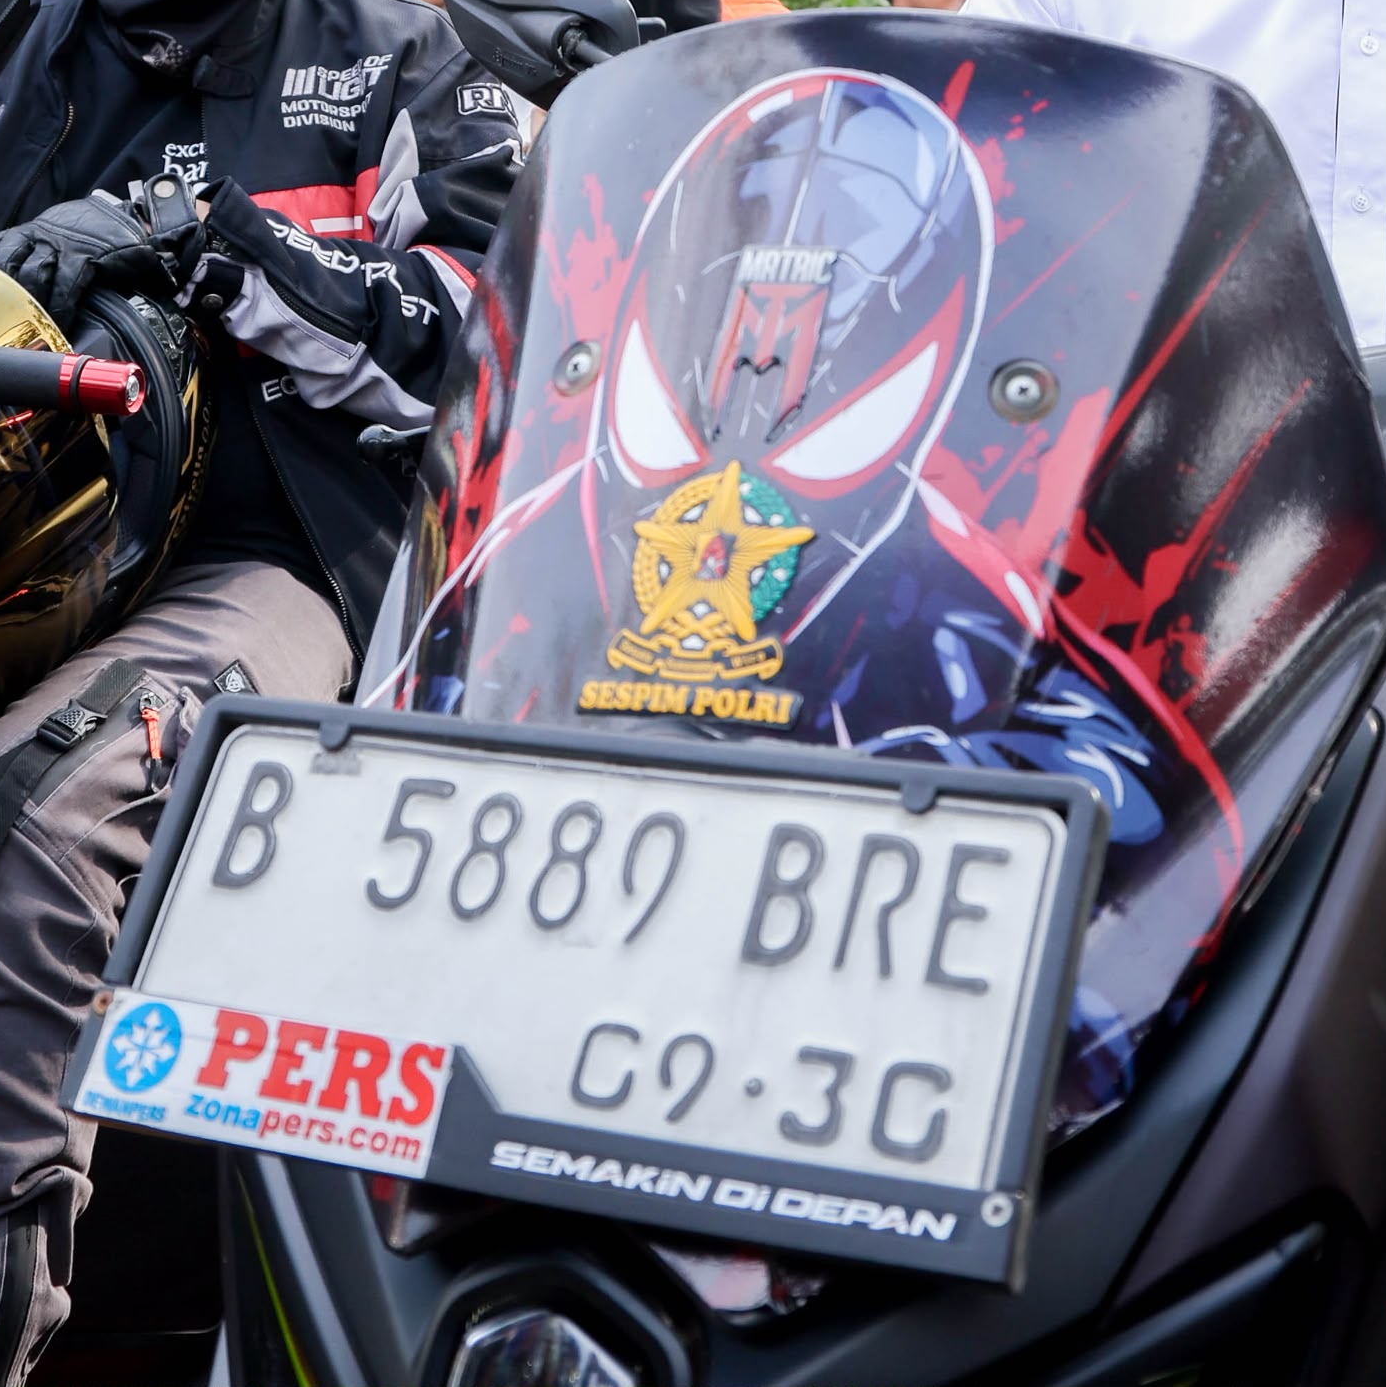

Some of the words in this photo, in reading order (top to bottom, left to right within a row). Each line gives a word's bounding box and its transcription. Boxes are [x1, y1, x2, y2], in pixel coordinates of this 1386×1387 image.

[363, 53, 393, 66] OF
[280, 91, 373, 118] MOTORSPOT
[283, 113, 355, 132] DIVISION
[738, 249, 837, 285] MATRIC
[579, 680, 689, 715] SESPIM
[691, 686, 794, 724] POLRI
[212, 761, 294, 889] B
[364, 777, 685, 945] 5889
[741, 822, 1011, 995] BRE
[196, 1007, 446, 1127] PERS
[184, 1094, 421, 1161] zonapers.com
[779, 1187, 957, 1244] DEPAN
